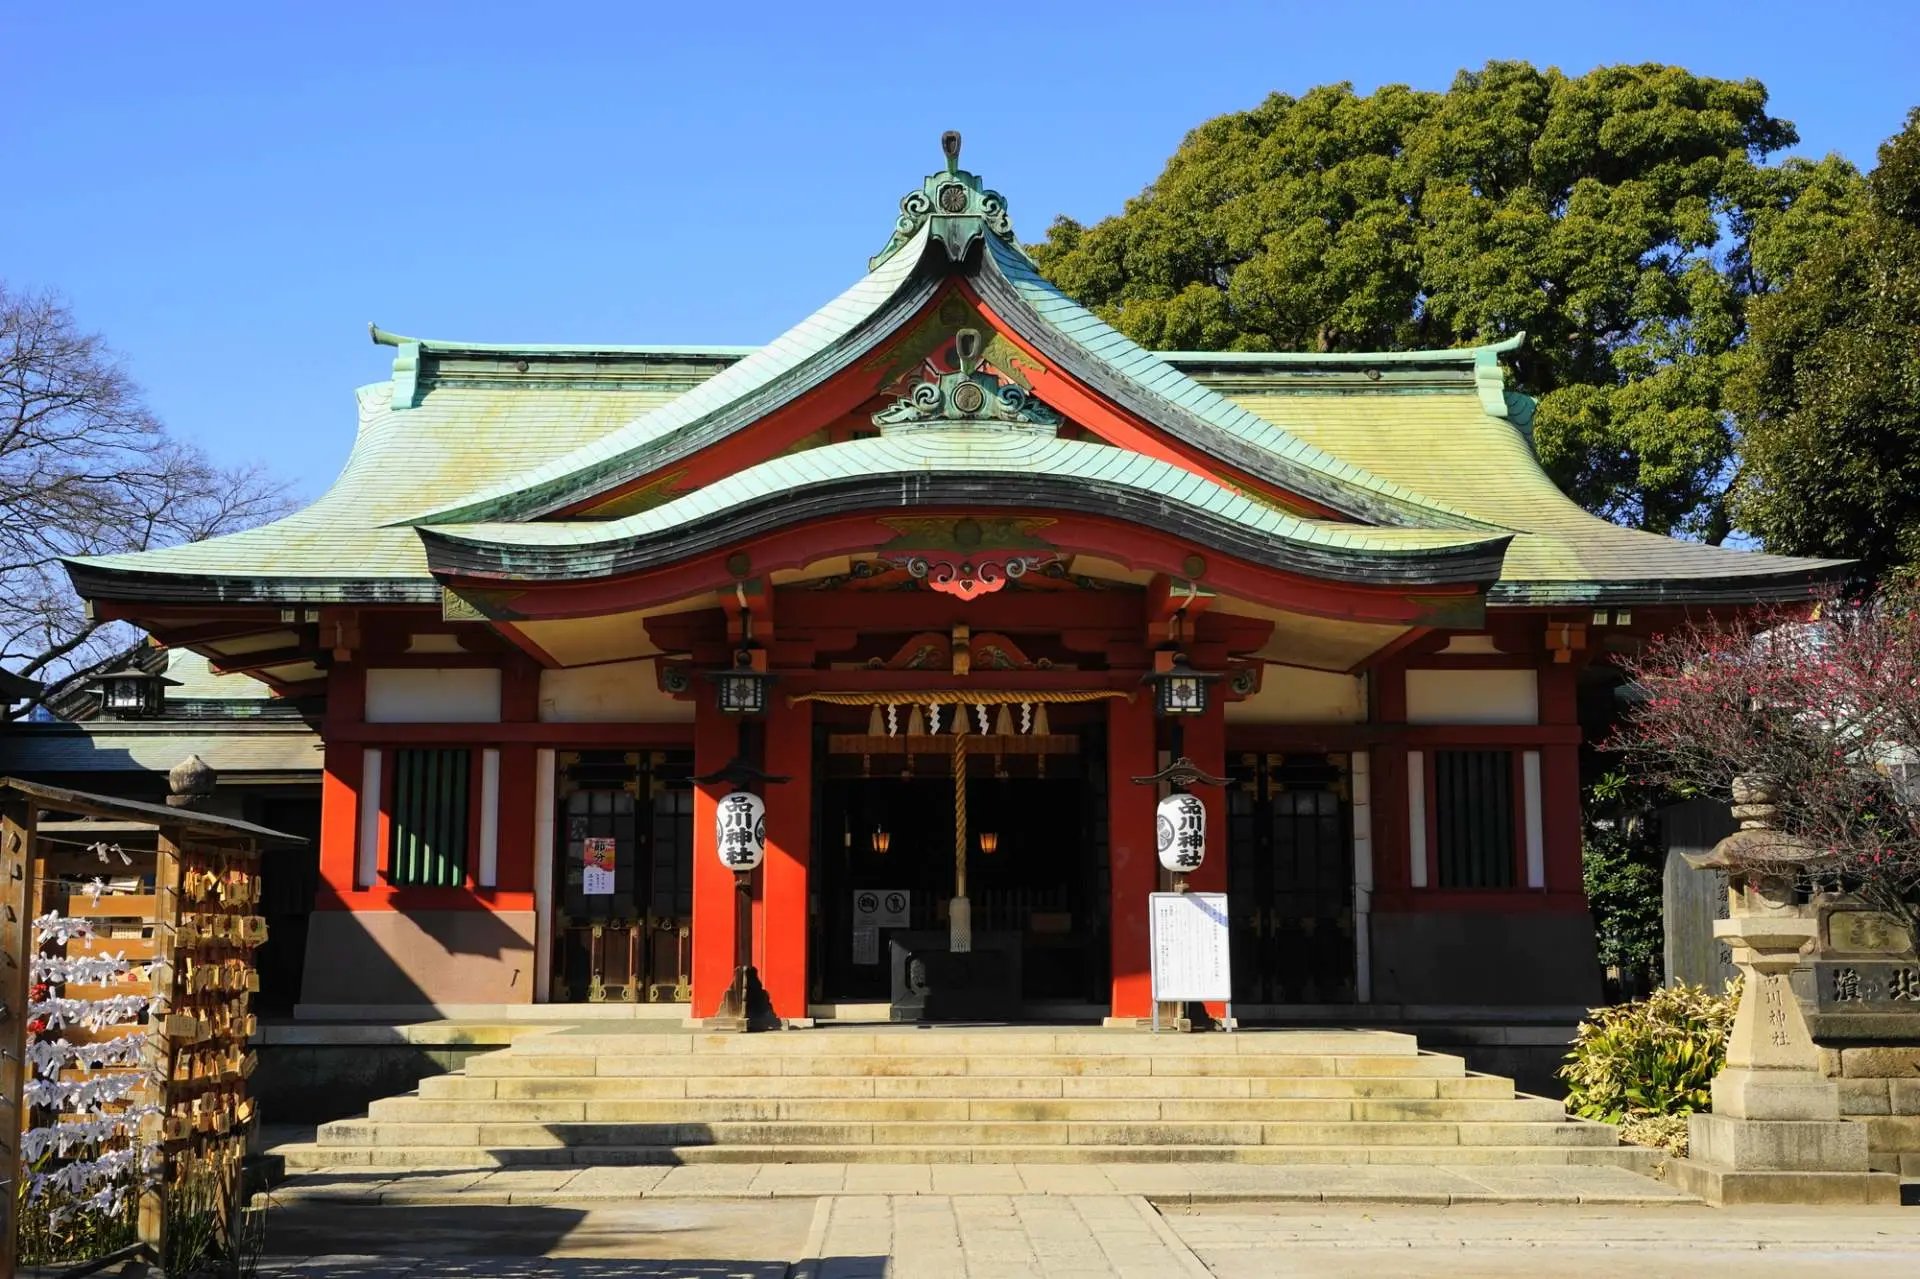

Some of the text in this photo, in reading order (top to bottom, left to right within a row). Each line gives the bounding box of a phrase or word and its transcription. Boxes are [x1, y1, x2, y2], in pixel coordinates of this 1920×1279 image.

[725, 796, 754, 865] 品川神社
[1176, 797, 1203, 867] 品川神社
